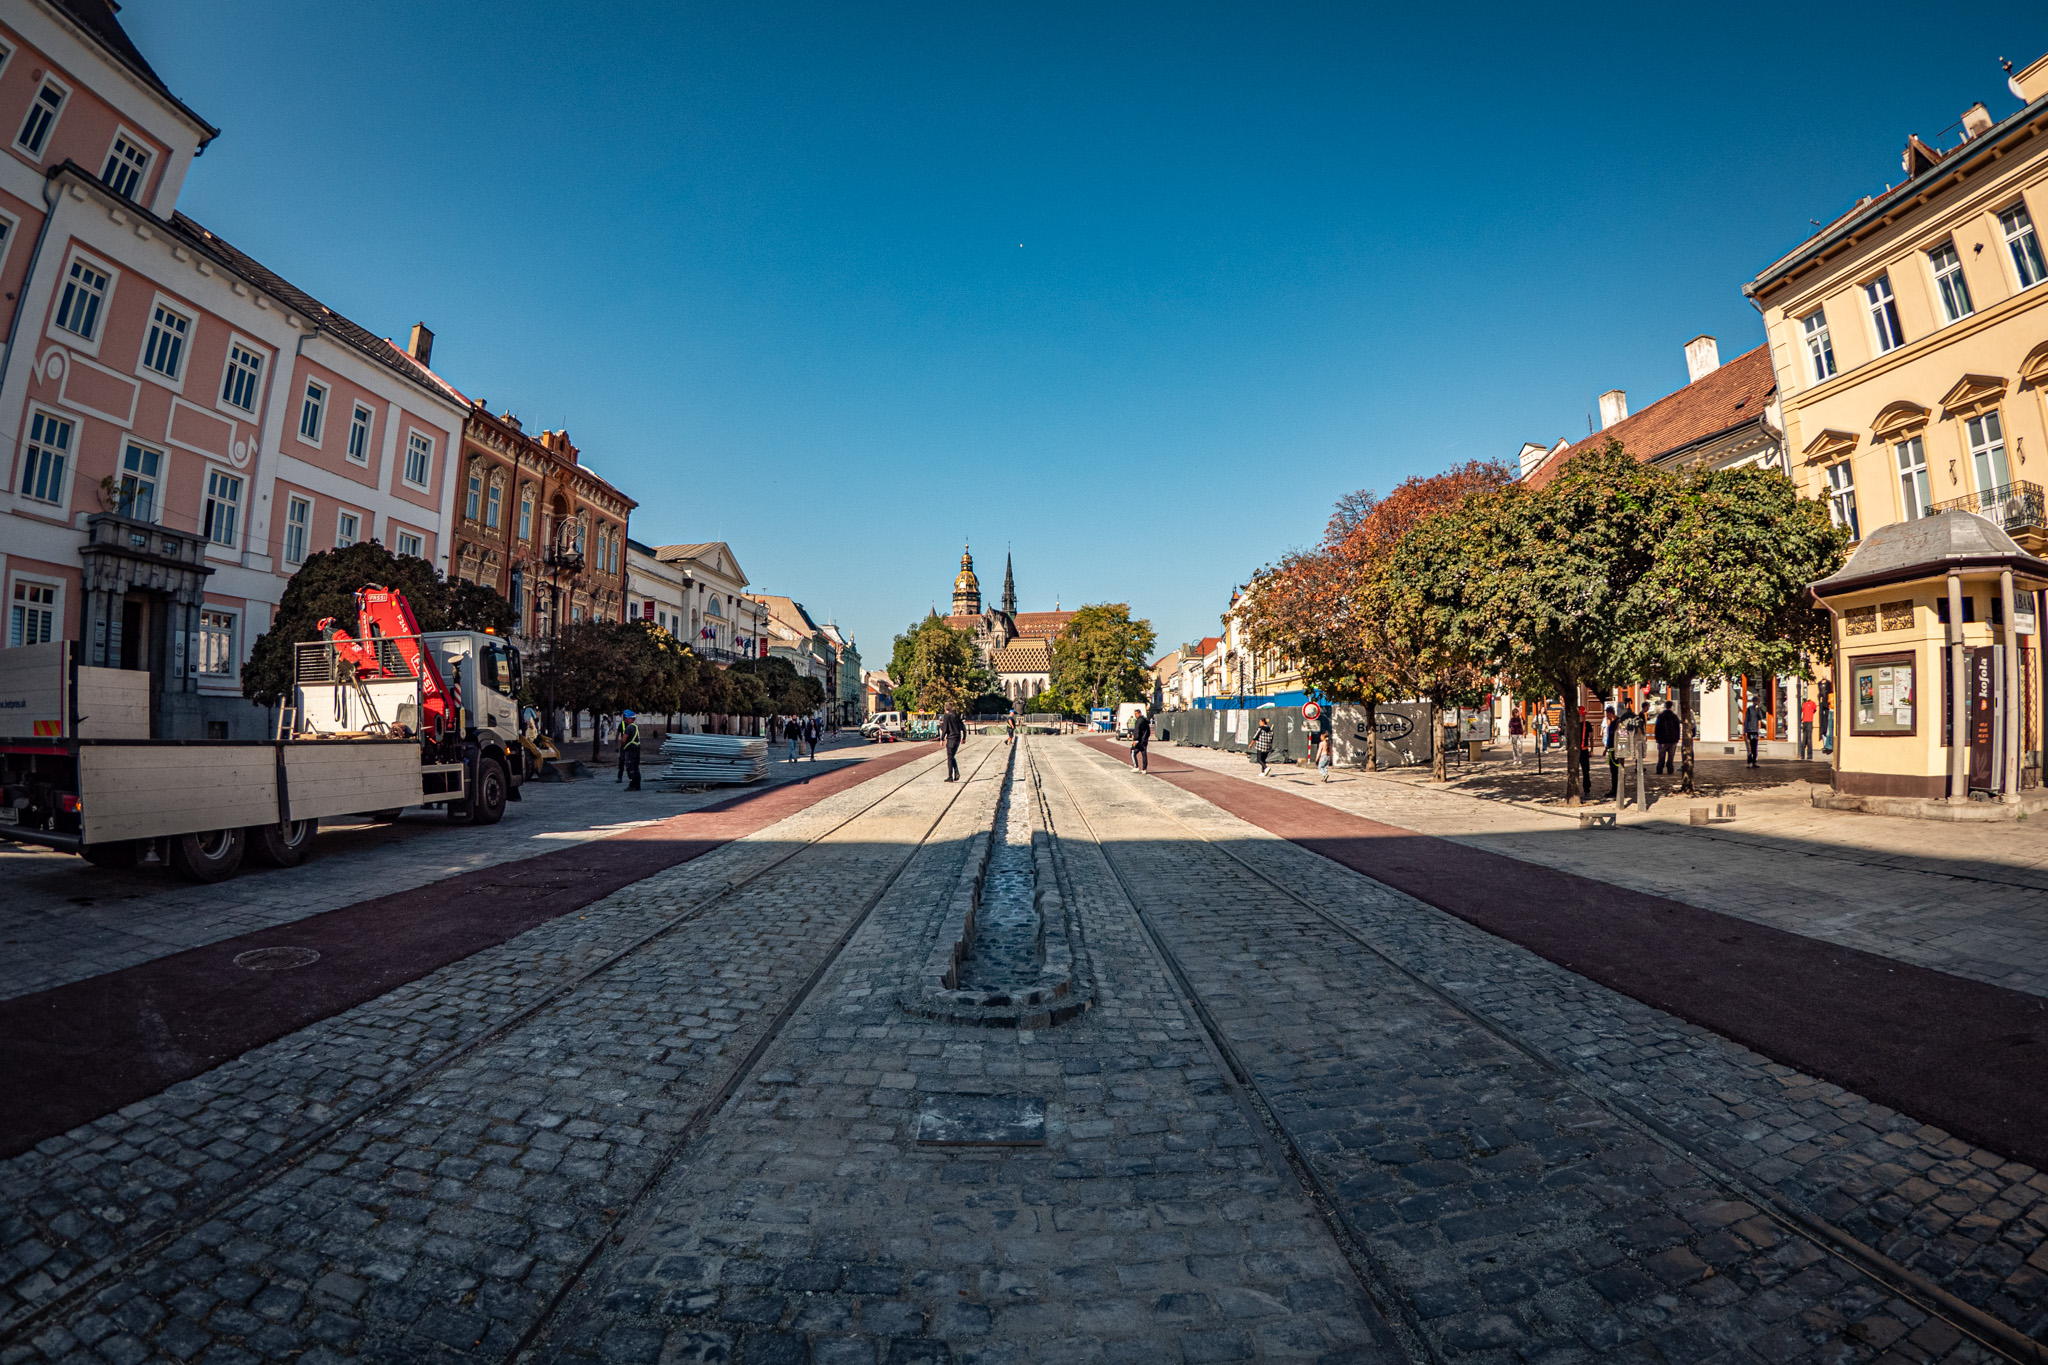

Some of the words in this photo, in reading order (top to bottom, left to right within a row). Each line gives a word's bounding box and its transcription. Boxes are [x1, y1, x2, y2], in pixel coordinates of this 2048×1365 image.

[2014, 594, 2033, 610] ABAK
[397, 614, 408, 632] F245
[414, 658, 433, 691] FSSI
[1979, 657, 1989, 698] kofola
